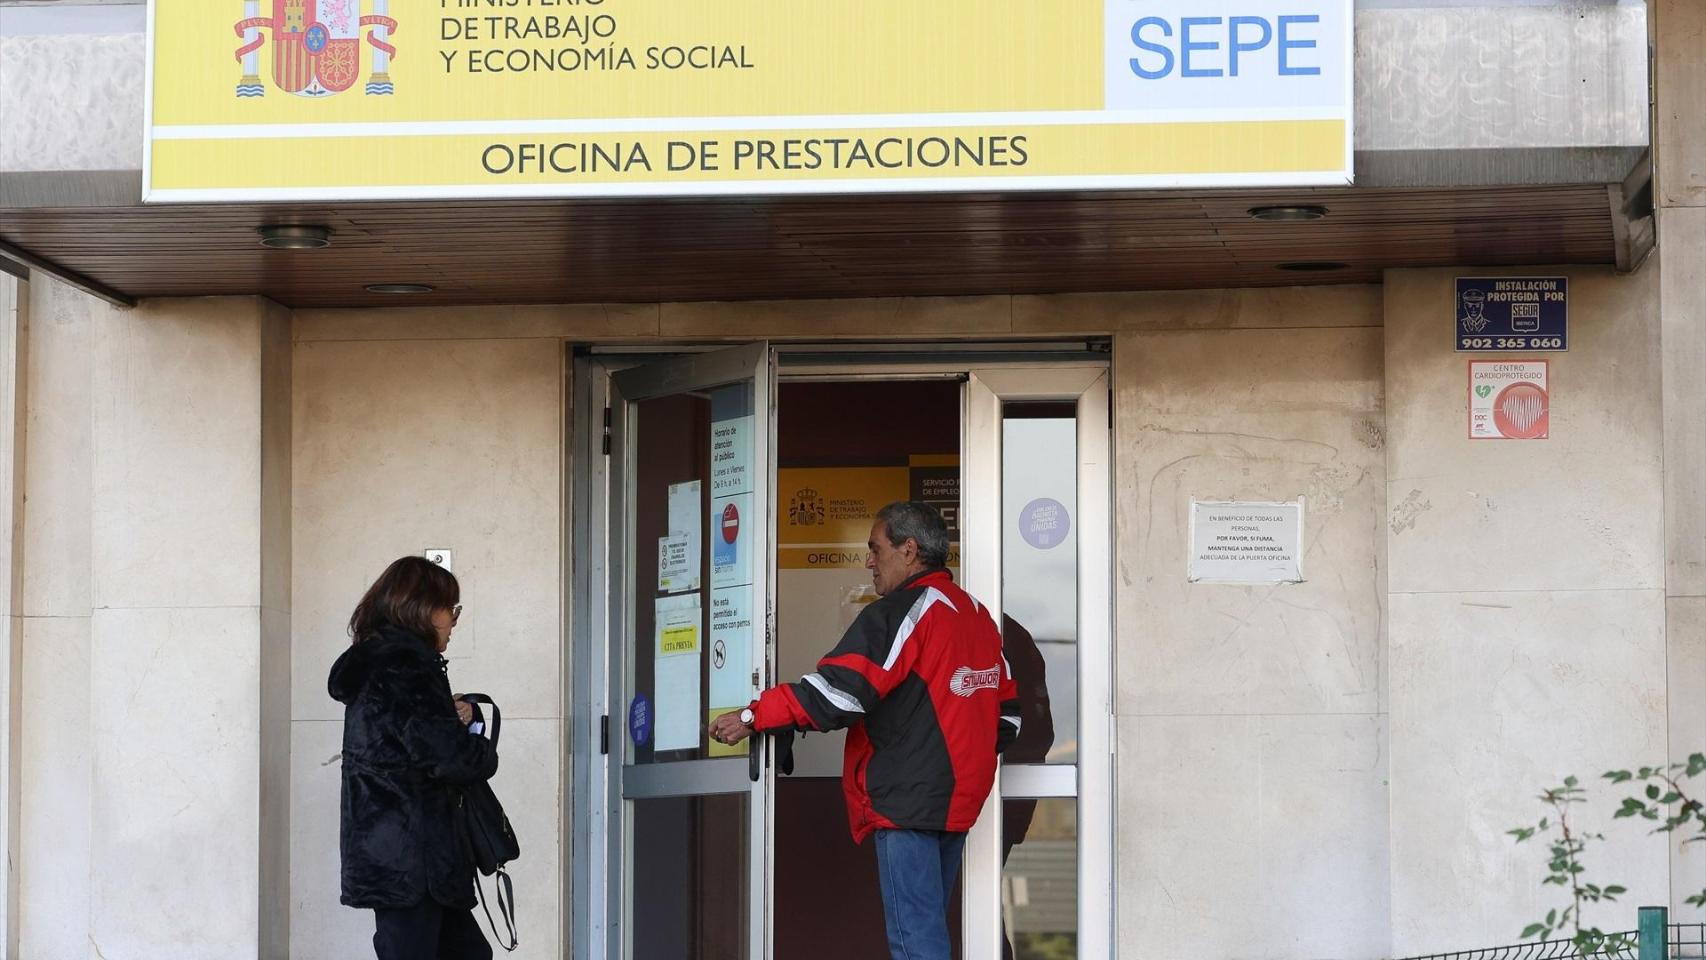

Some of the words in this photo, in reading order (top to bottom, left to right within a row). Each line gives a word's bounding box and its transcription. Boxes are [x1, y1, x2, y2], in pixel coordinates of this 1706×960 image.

[441, 17, 478, 40] DE
[484, 15, 617, 44] TRABAJO
[1129, 14, 1323, 80] SEPE
[440, 50, 458, 73] Y
[468, 42, 637, 72] ECONOMÍA
[646, 45, 755, 70] SOCIAL
[481, 142, 653, 174] OFICINA
[667, 141, 719, 171] DE
[734, 135, 1028, 170] PRESTACIONES
[1495, 280, 1557, 291] INSTALACIÓN
[1487, 292, 1540, 302] PROTEGIDA
[1544, 292, 1565, 302] POR
[1512, 304, 1539, 317] SEGUR
[1461, 338, 1493, 349] 902
[1496, 338, 1526, 349] 365
[1530, 338, 1562, 349] 060
[1493, 364, 1525, 372] CENTRO
[714, 427, 730, 437] Horario
[730, 426, 737, 435] de
[714, 439, 733, 449] atención
[714, 452, 719, 462] al
[719, 451, 735, 462] público
[807, 553, 861, 564] OFICINA
[713, 599, 719, 607] No
[713, 609, 733, 619] permitido
[733, 607, 738, 617] el
[713, 622, 728, 630] acceso
[728, 621, 737, 629] con
[737, 619, 751, 630] perros
[664, 642, 675, 651] CITA
[676, 640, 693, 650] PREVIA
